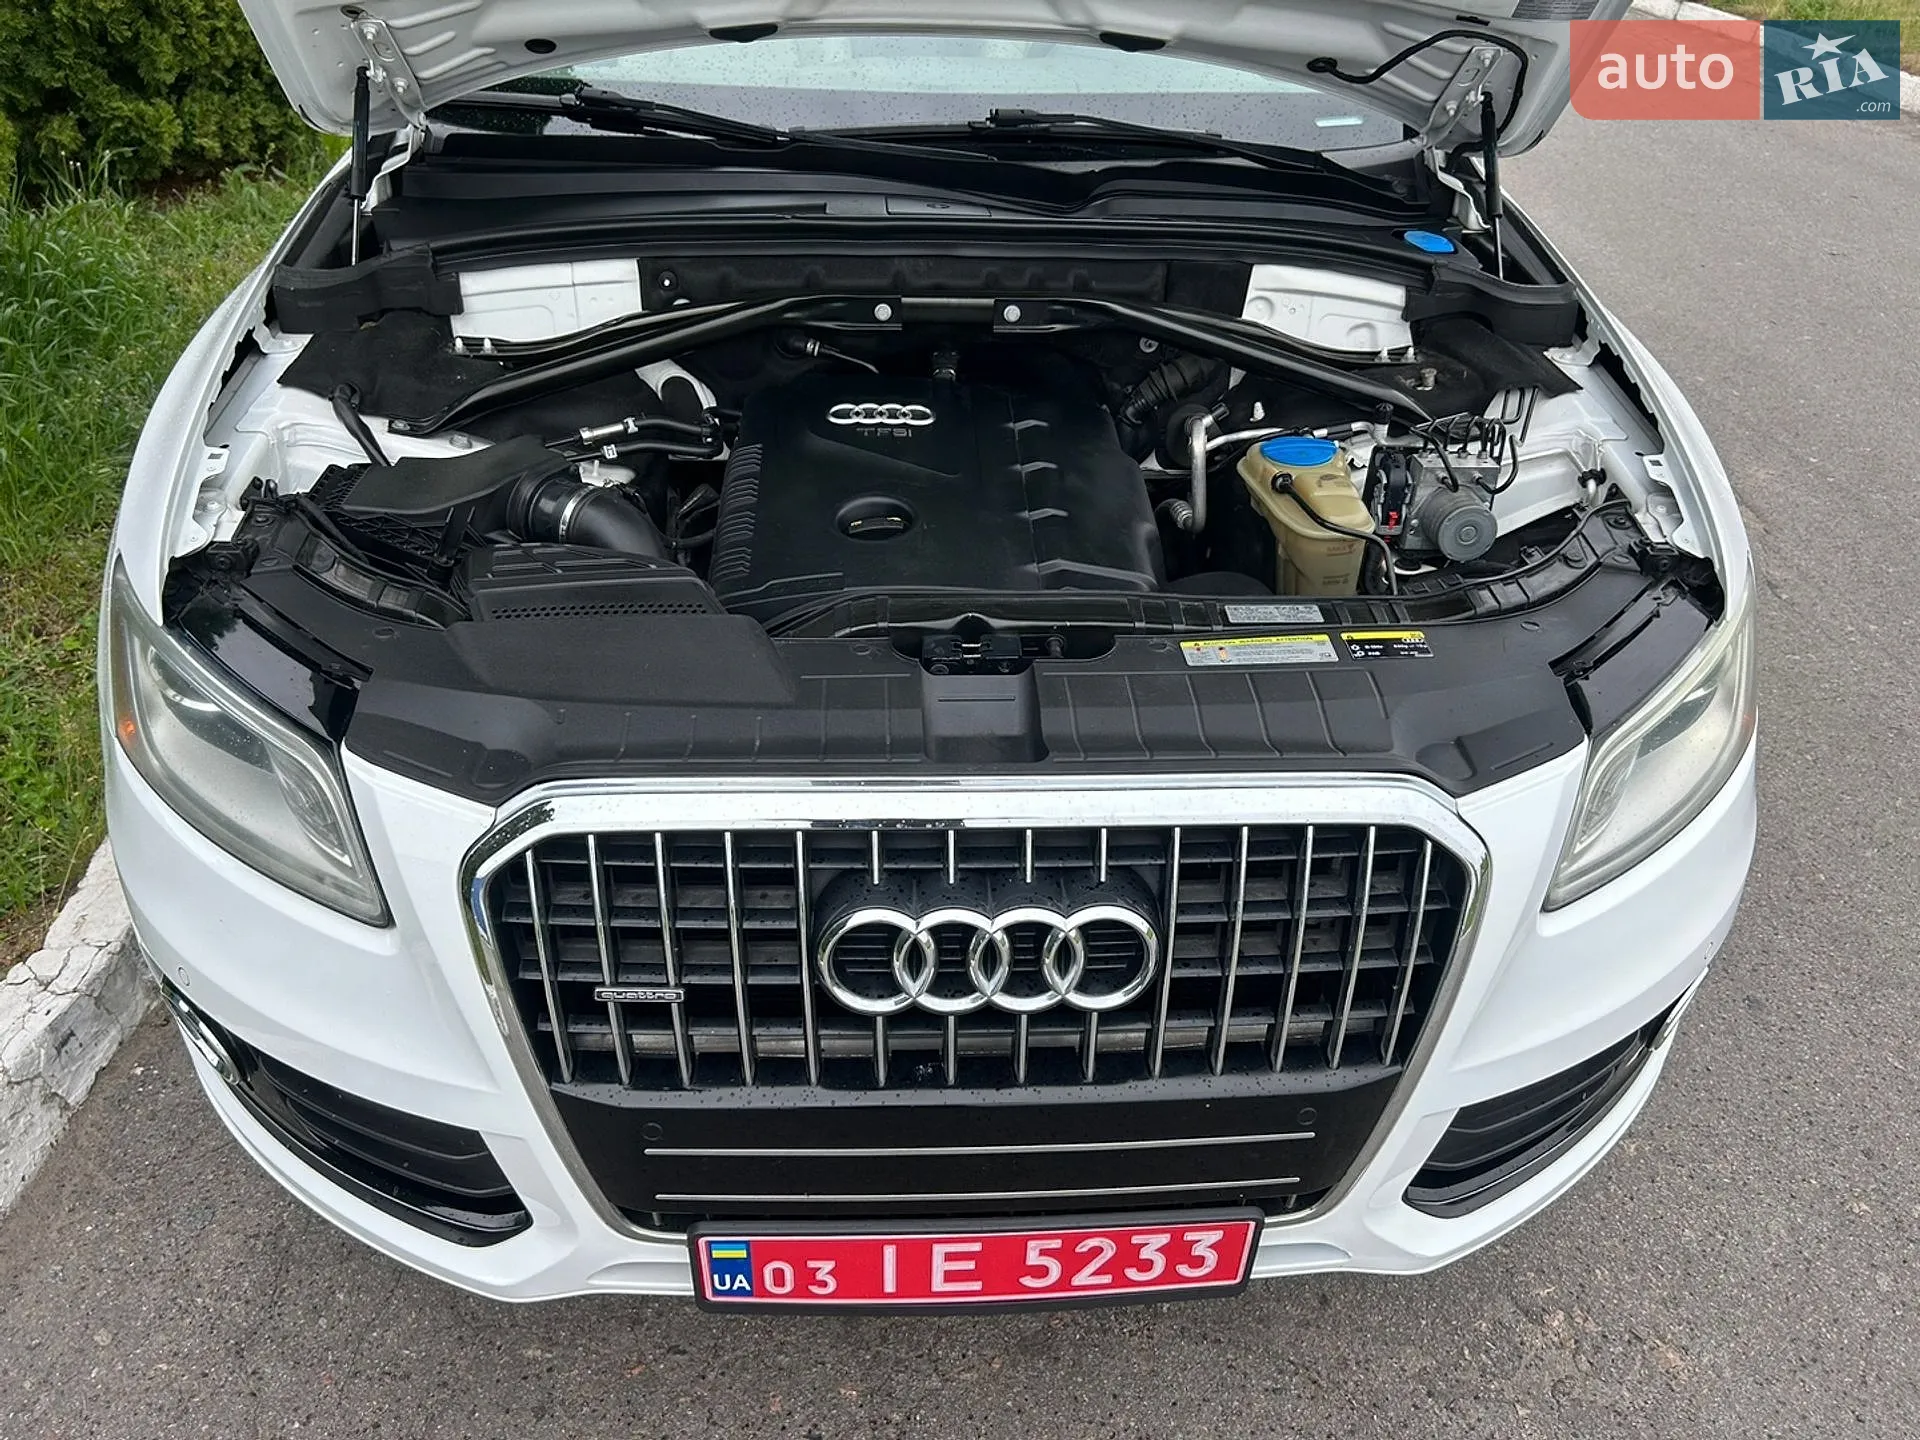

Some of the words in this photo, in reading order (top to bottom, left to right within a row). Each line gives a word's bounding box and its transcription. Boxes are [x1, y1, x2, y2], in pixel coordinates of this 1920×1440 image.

[856, 428, 912, 437] TFSI
[601, 992, 677, 1001] quattro
[713, 1274, 751, 1291] UA
[763, 1260, 838, 1295] 03
[1018, 1230, 1224, 1288] 5233
